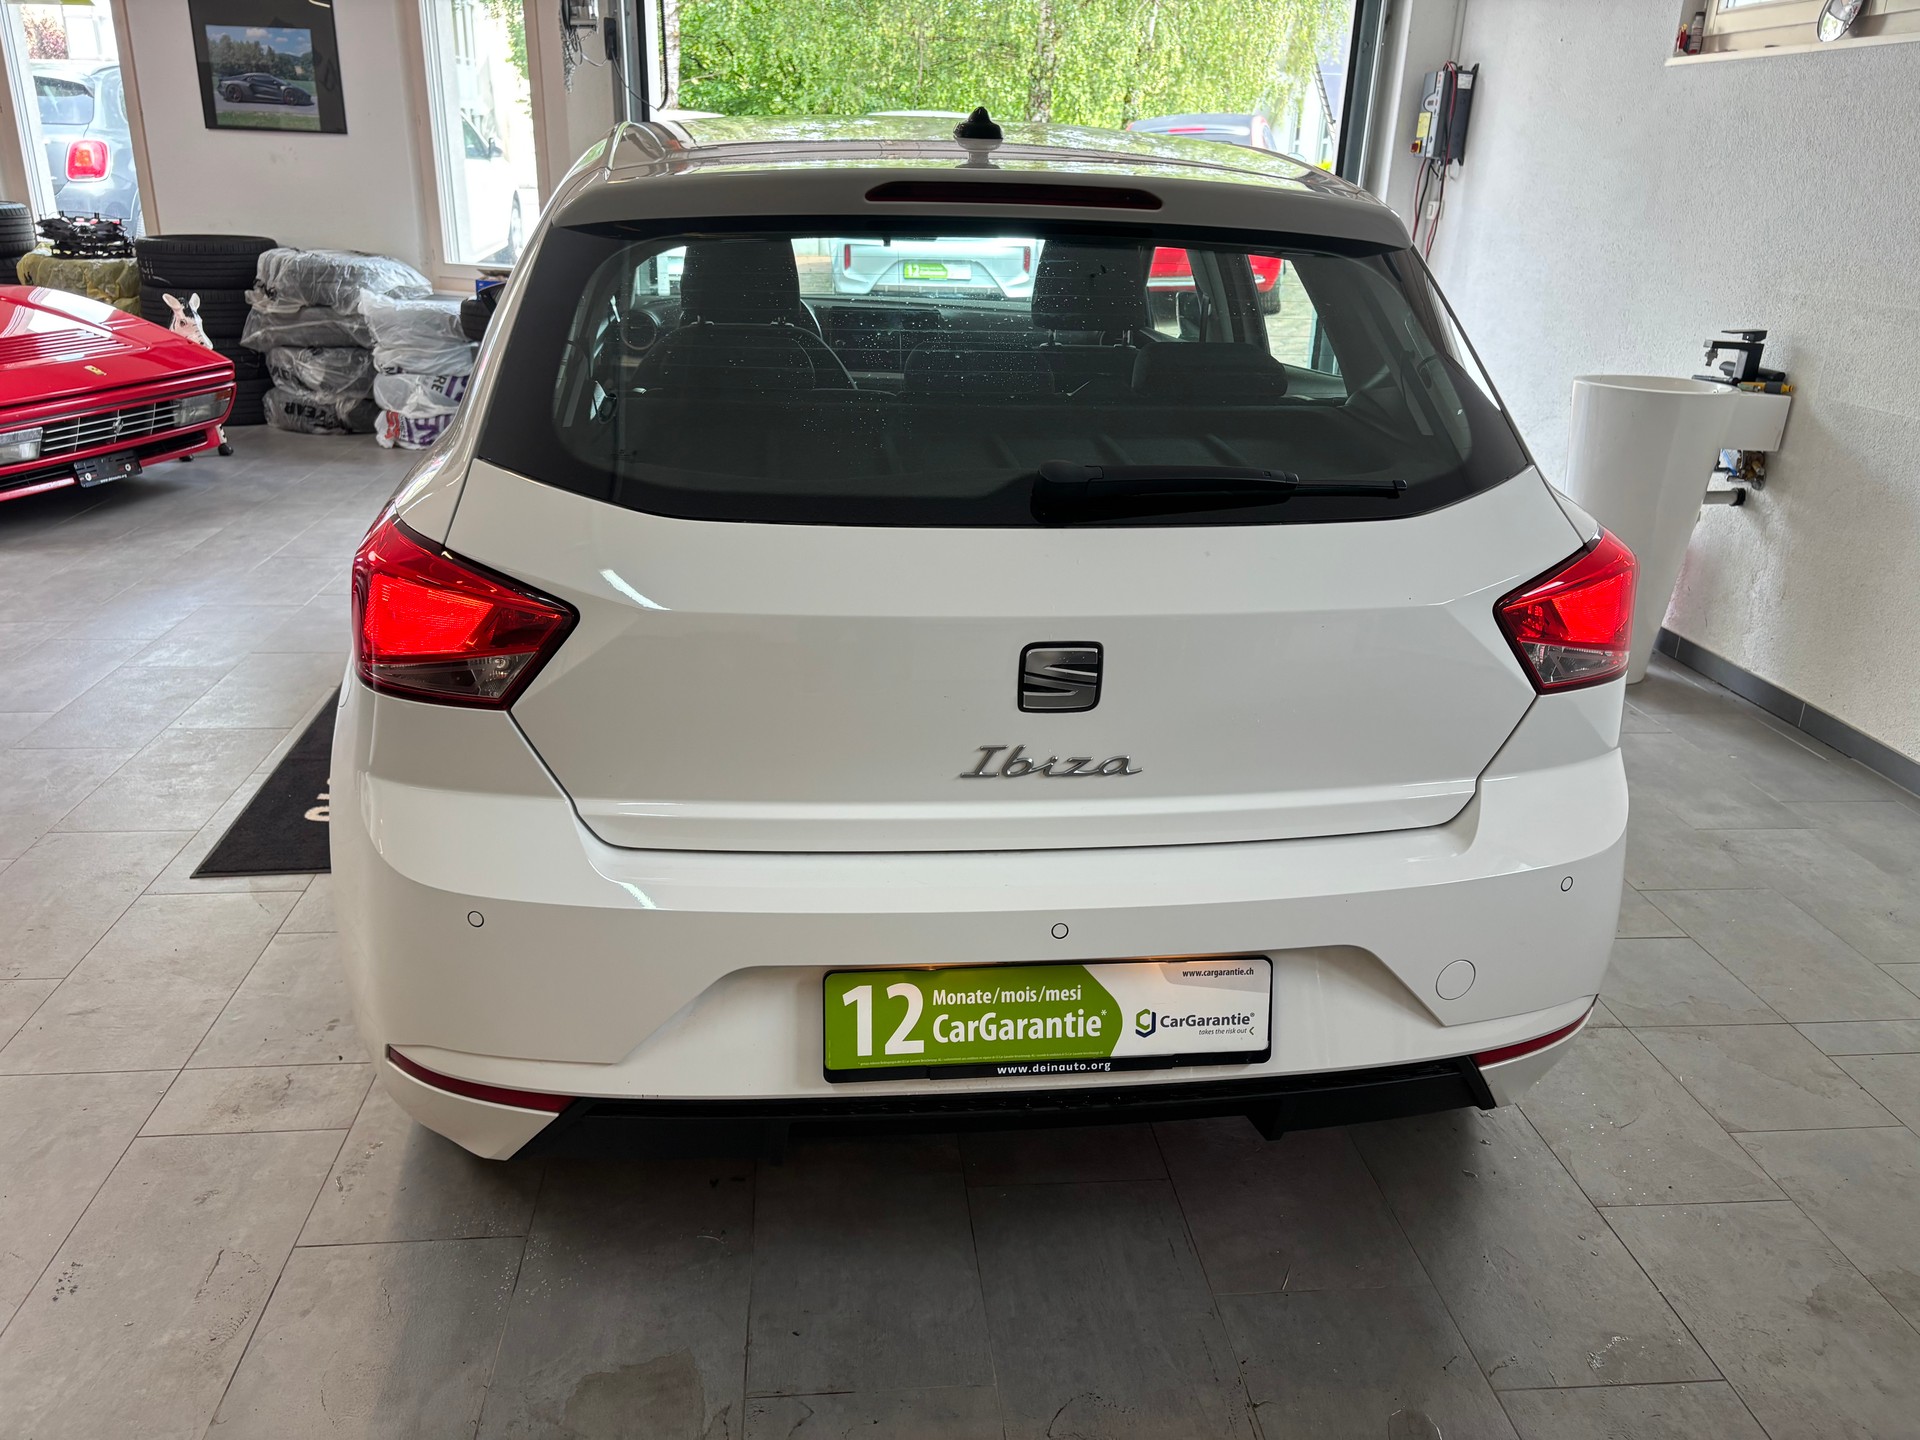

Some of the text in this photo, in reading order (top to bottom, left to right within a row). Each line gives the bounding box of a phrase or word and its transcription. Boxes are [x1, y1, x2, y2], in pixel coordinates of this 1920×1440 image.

[959, 743, 1144, 778] Ibiza
[1182, 967, 1254, 979] www.cargarantie.ch
[842, 982, 925, 1057] 12
[1198, 1027, 1248, 1036] takes the risk out
[996, 1062, 1112, 1075] www.deinauto.org
